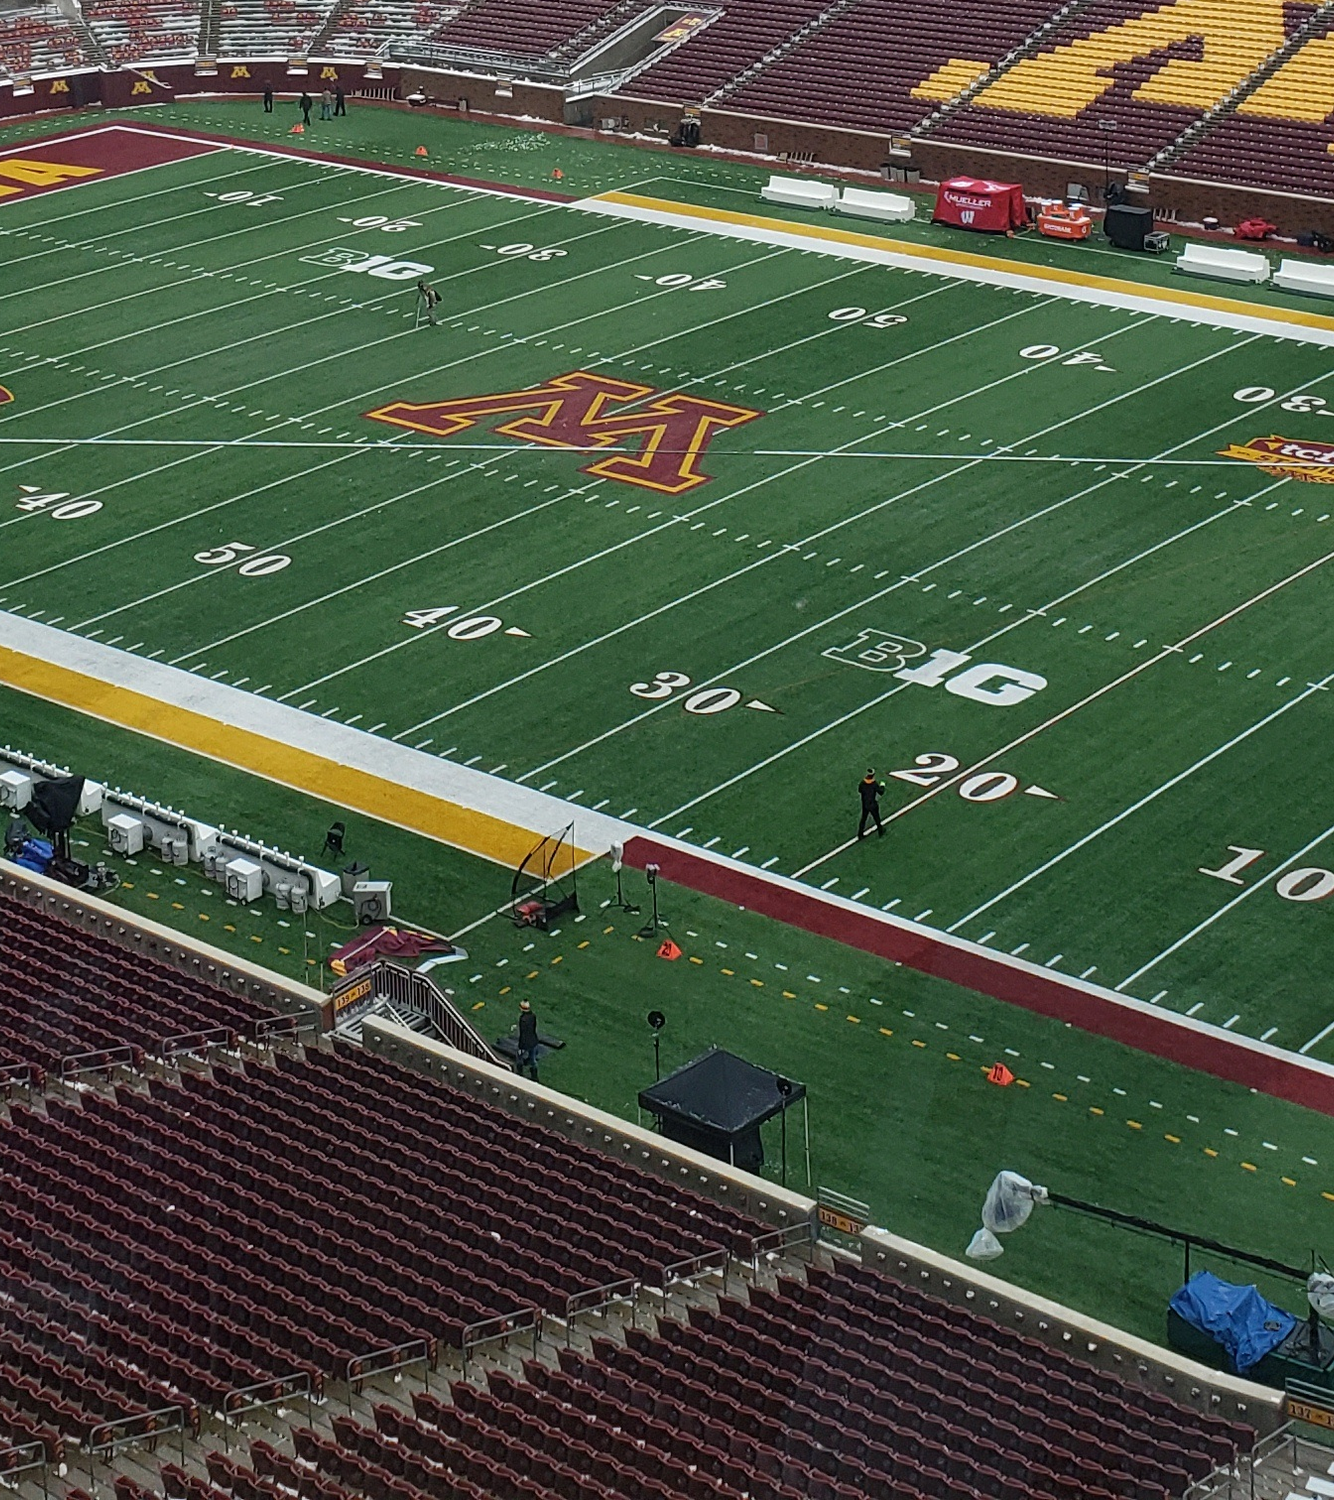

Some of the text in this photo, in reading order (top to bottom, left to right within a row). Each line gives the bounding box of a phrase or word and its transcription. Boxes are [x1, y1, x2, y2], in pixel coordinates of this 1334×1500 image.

[217, 190, 284, 207] 10
[949, 195, 992, 208] MUELLER
[353, 215, 423, 233] 20
[497, 243, 568, 262] 30
[654, 272, 728, 293] 40
[827, 306, 909, 330] 50
[1019, 344, 1103, 367] 40
[1232, 386, 1327, 415] 30
[15, 487, 104, 520] 40
[193, 542, 293, 577] 50
[402, 604, 503, 641] 40
[628, 670, 743, 715] 30
[889, 751, 1021, 803] 20
[1291, 1404, 1311, 1420] 137
